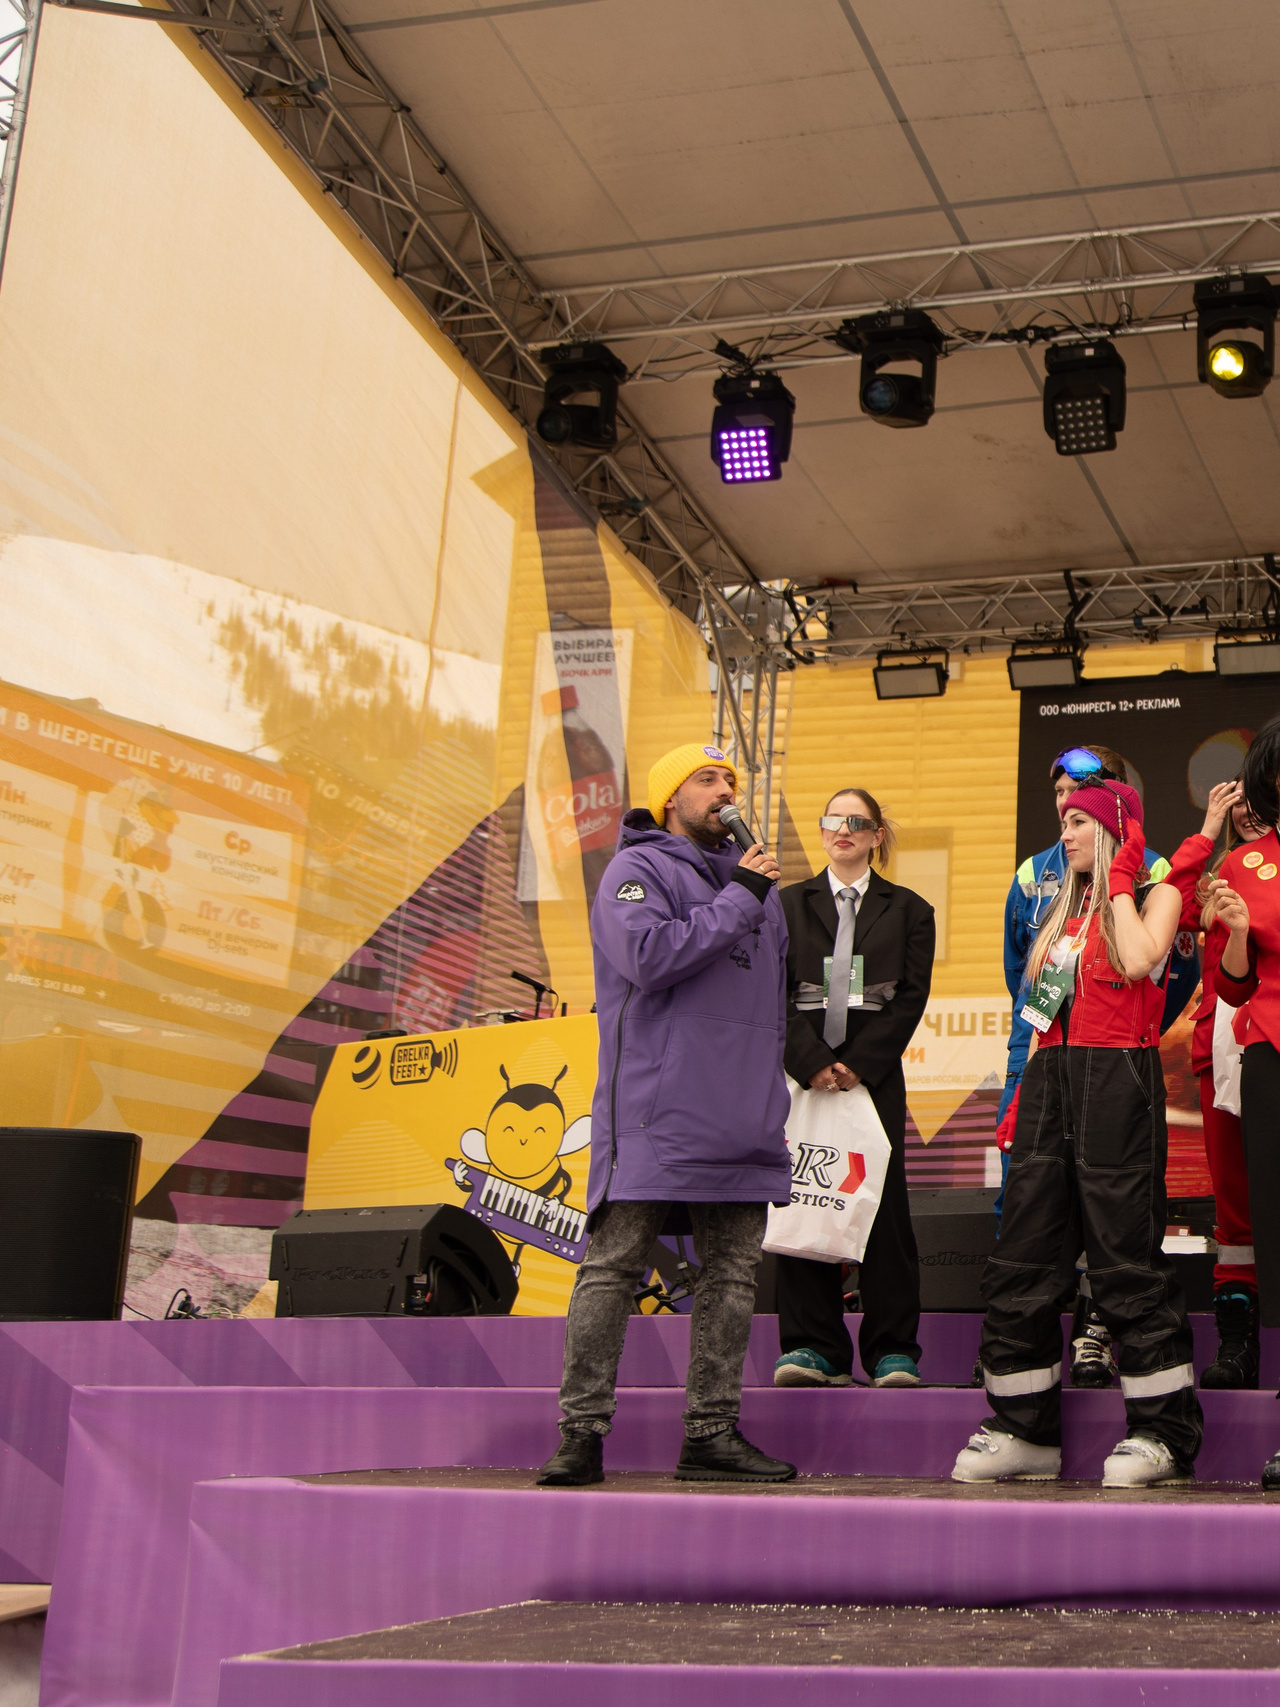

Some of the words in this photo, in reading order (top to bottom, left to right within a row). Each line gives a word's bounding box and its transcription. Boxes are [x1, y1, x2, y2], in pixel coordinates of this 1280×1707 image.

[560, 668, 613, 679] БОЧКАРИ
[1040, 705, 1060, 716] ООО
[1062, 701, 1116, 714] «ЮНИРЕСТ»
[1119, 701, 1134, 712] 12+
[1137, 698, 1181, 710] РЕКЛАМА
[15, 711, 30, 732] В
[38, 717, 163, 770] ШЕРЕГЕШЕ
[169, 754, 216, 784] УЖЕ
[221, 772, 242, 793] 10
[247, 780, 293, 806] ЛЕТ!
[545, 782, 616, 824] Cola
[0, 810, 53, 832] тирник
[194, 850, 278, 877] акустический
[211, 865, 261, 885] концерт
[177, 923, 211, 937] днем
[225, 932, 280, 952] вечером
[43, 978, 61, 991] SKI
[1038, 997, 1049, 1008] 77
[924, 1012, 1012, 1037] ЧШЕЕ
[397, 1046, 430, 1064] GRELKA
[396, 1062, 418, 1080] FEST
[933, 1074, 962, 1084] РОССИИ
[791, 1142, 841, 1189] R
[790, 1191, 846, 1211] STIC'S
